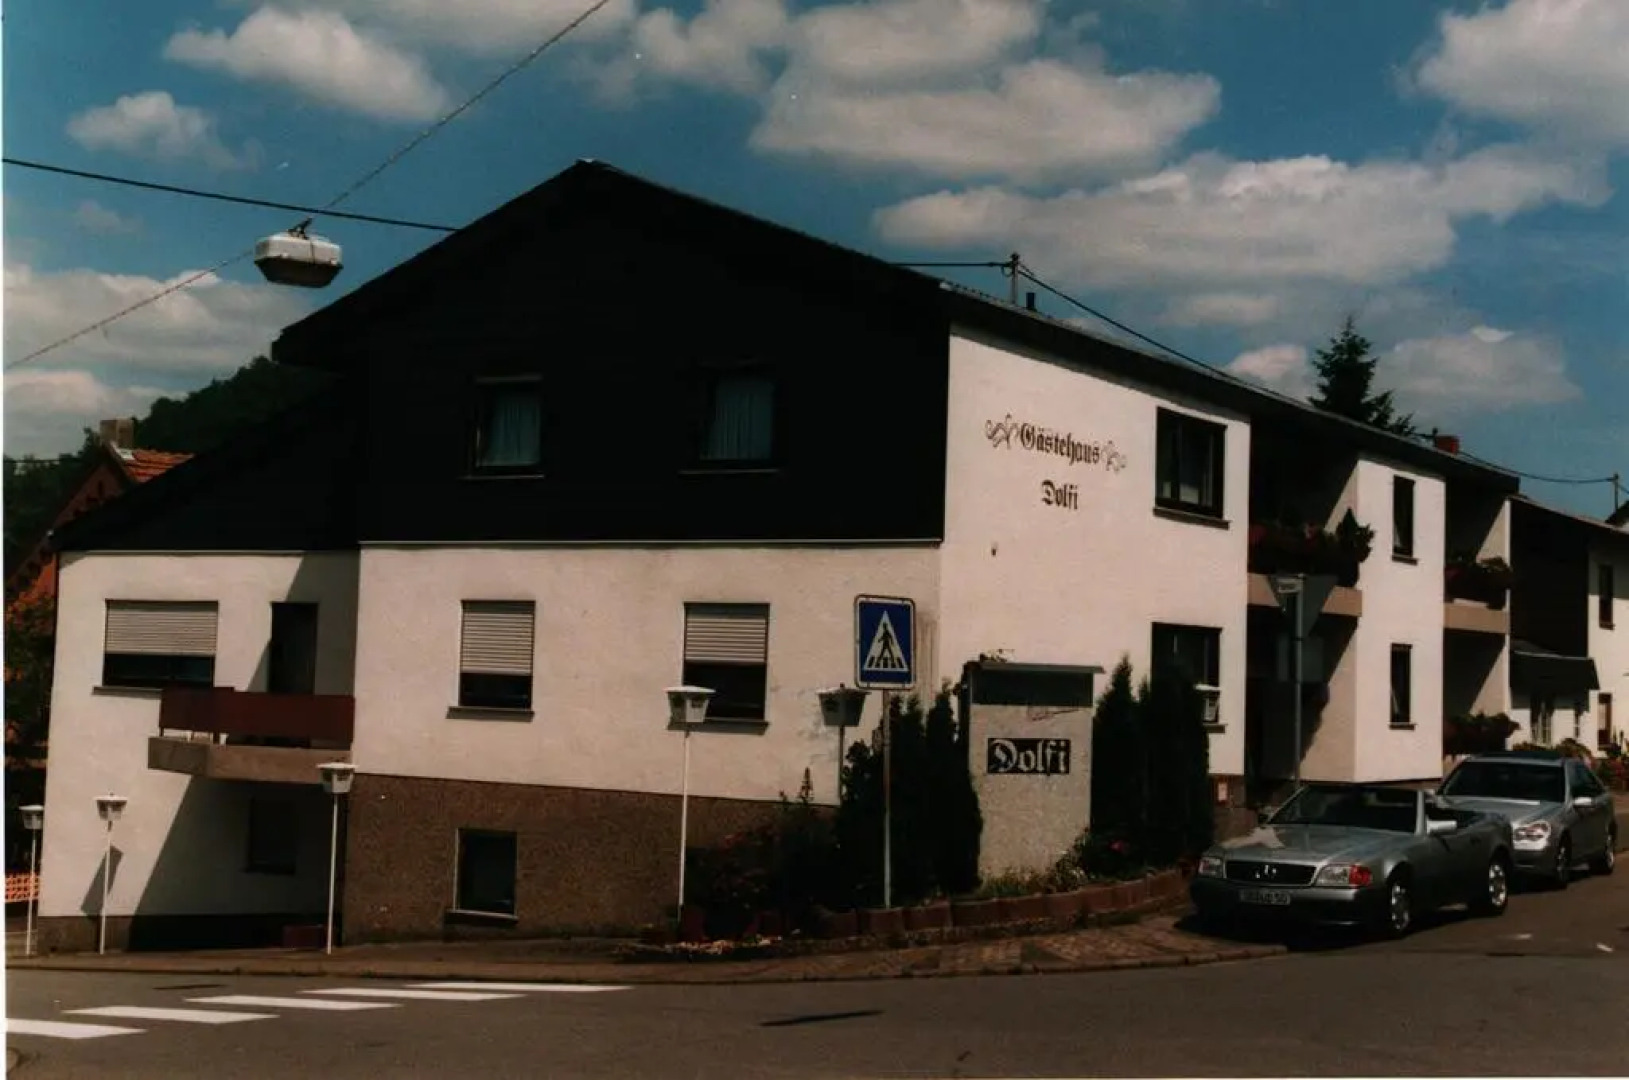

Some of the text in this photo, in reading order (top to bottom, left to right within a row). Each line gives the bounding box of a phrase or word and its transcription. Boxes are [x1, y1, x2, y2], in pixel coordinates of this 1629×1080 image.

[1020, 423, 1100, 465] Gästehaus
[1041, 479, 1078, 509] Dolfi
[989, 739, 1067, 773] Dolfi
